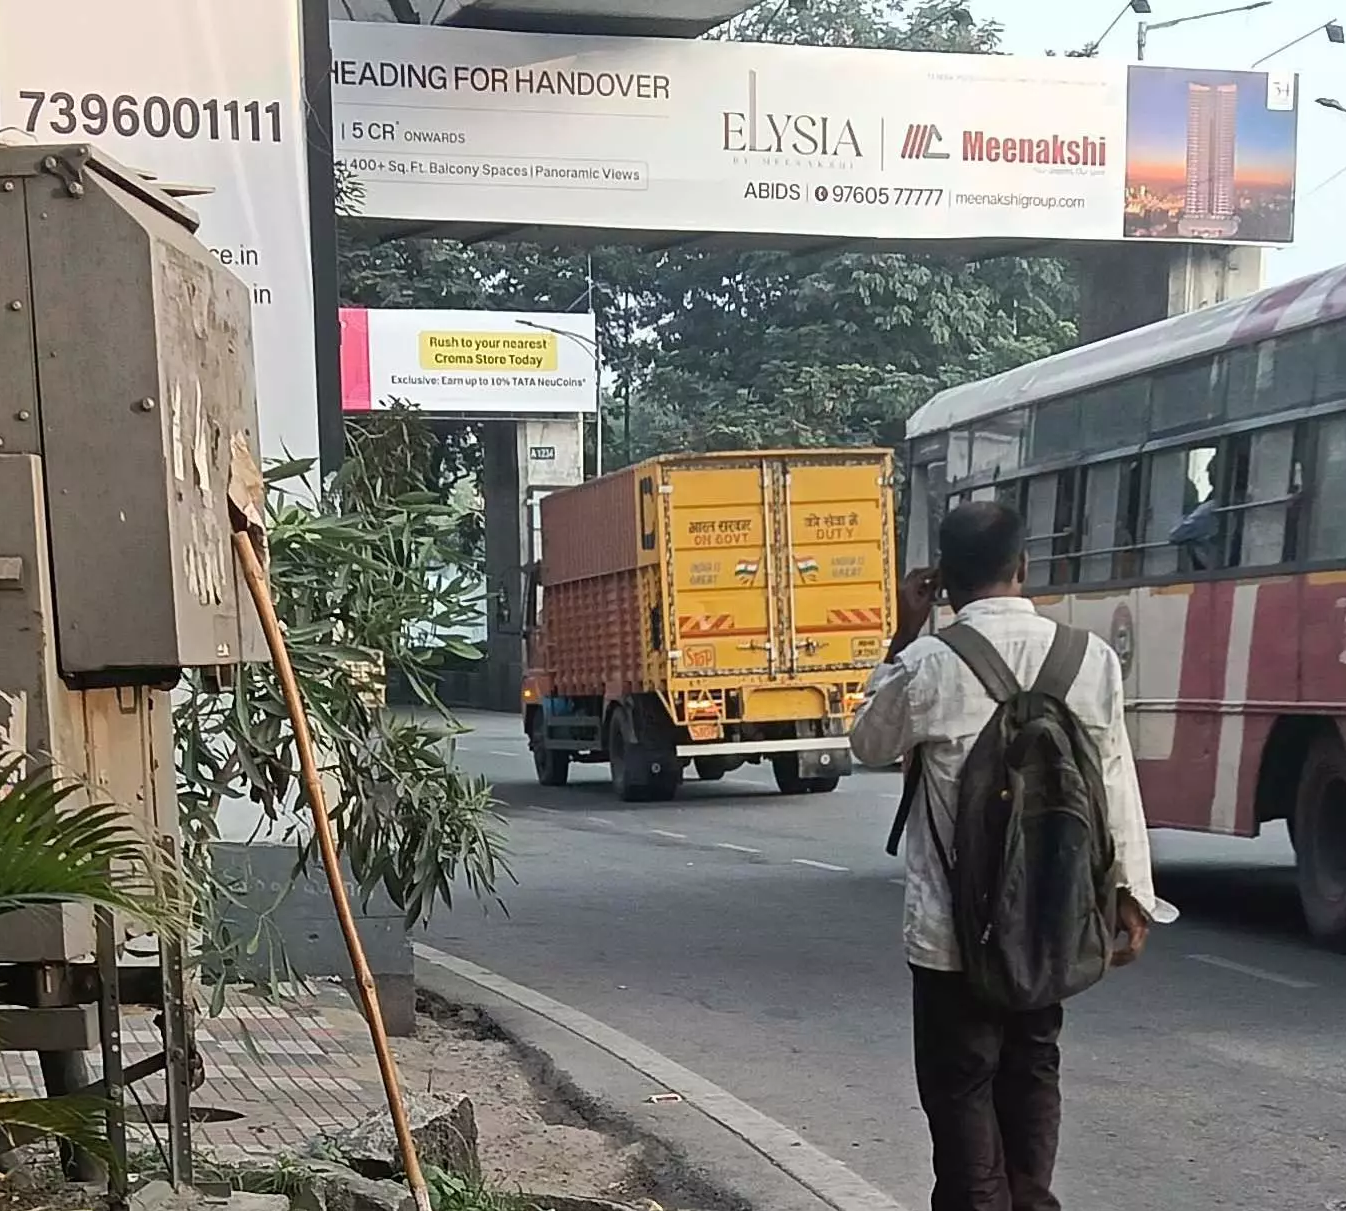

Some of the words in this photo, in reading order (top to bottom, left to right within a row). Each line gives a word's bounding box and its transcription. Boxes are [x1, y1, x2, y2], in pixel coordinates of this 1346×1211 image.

[330, 61, 447, 90] HEADING
[454, 67, 508, 93] FOR
[516, 69, 670, 99] HANDOVER
[19, 90, 281, 142] 7396001111
[722, 69, 863, 157] ELYSIA
[352, 122, 364, 139] 5
[404, 131, 466, 143] ONWARDS
[962, 130, 1106, 167] Meenakshi
[350, 159, 385, 171] 400+
[429, 162, 479, 177] Balcony
[482, 164, 528, 178] Spaces
[535, 166, 599, 179] Panoramic
[603, 168, 640, 181] Views
[744, 182, 801, 200] ABIDS
[832, 185, 890, 204] 97605
[893, 187, 943, 207] 77777
[955, 191, 1085, 210] meenakshigroup.com
[429, 337, 459, 348] Rush
[461, 337, 473, 348] to
[474, 340, 500, 351] your
[503, 339, 547, 350] nearest
[475, 354, 506, 365] Store
[508, 355, 543, 367] Today
[391, 375, 440, 385] Exclusive:
[441, 376, 464, 386] Earn
[465, 378, 477, 387] up
[478, 377, 489, 386] to
[491, 377, 510, 386] 10%
[512, 378, 536, 387] TATA
[715, 532, 749, 545] GOVT
[816, 527, 855, 540] DUTY
